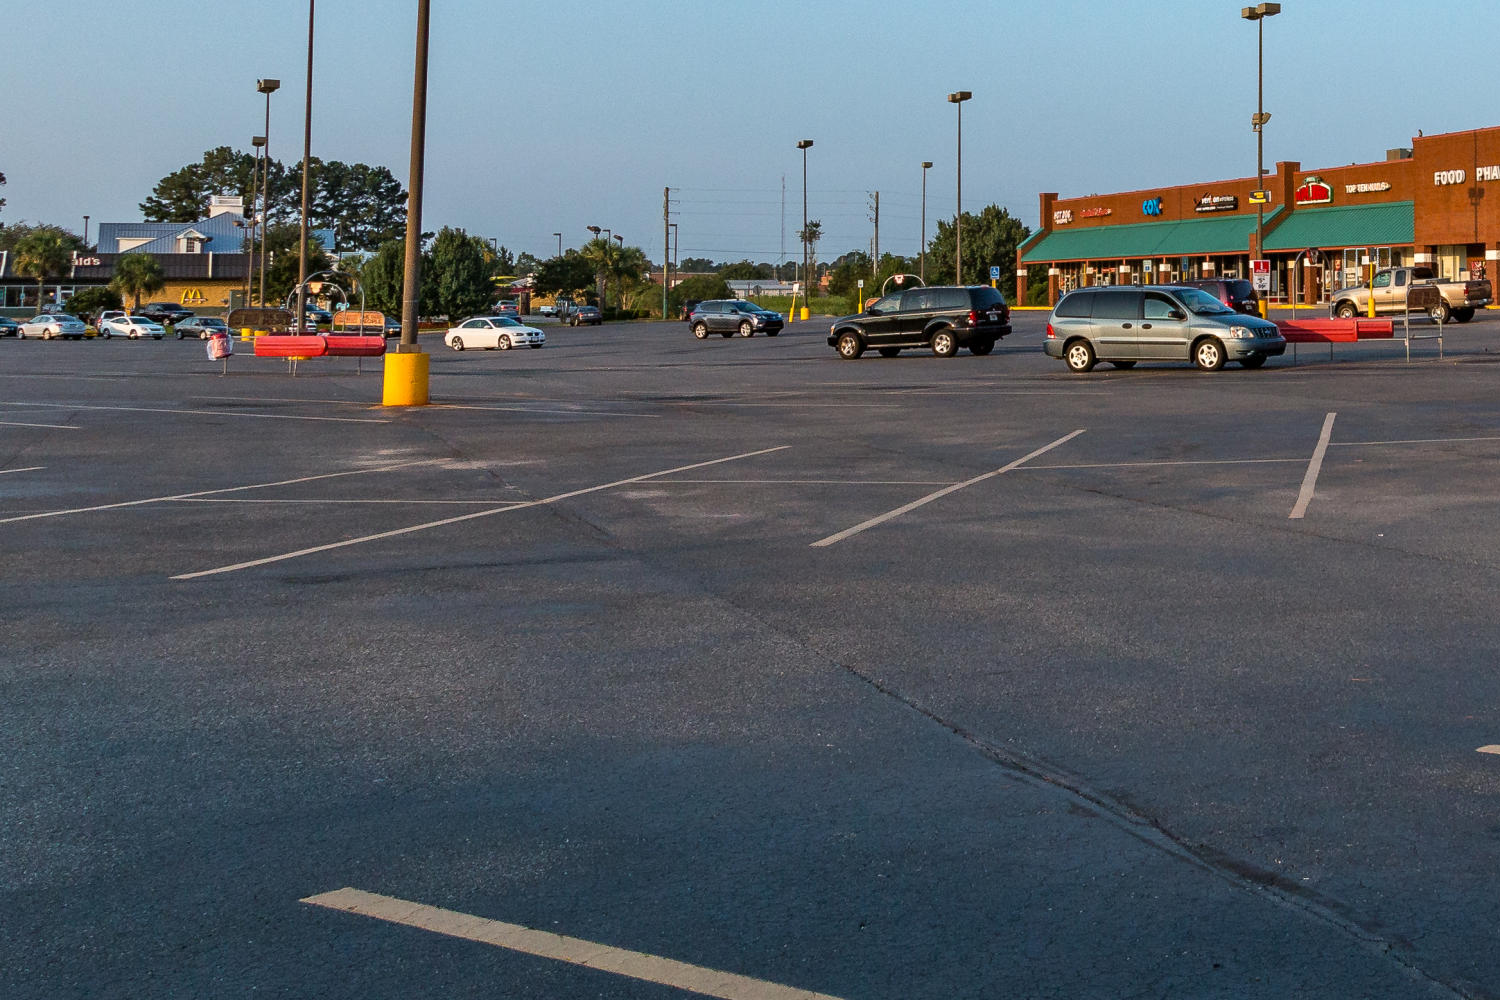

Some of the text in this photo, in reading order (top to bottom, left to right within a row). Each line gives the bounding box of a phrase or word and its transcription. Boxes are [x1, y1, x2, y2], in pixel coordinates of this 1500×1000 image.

[1434, 169, 1466, 186] FOOD
[1345, 185, 1357, 193] TOP
[1142, 199, 1161, 216] COX
[72, 257, 101, 266] ald's
